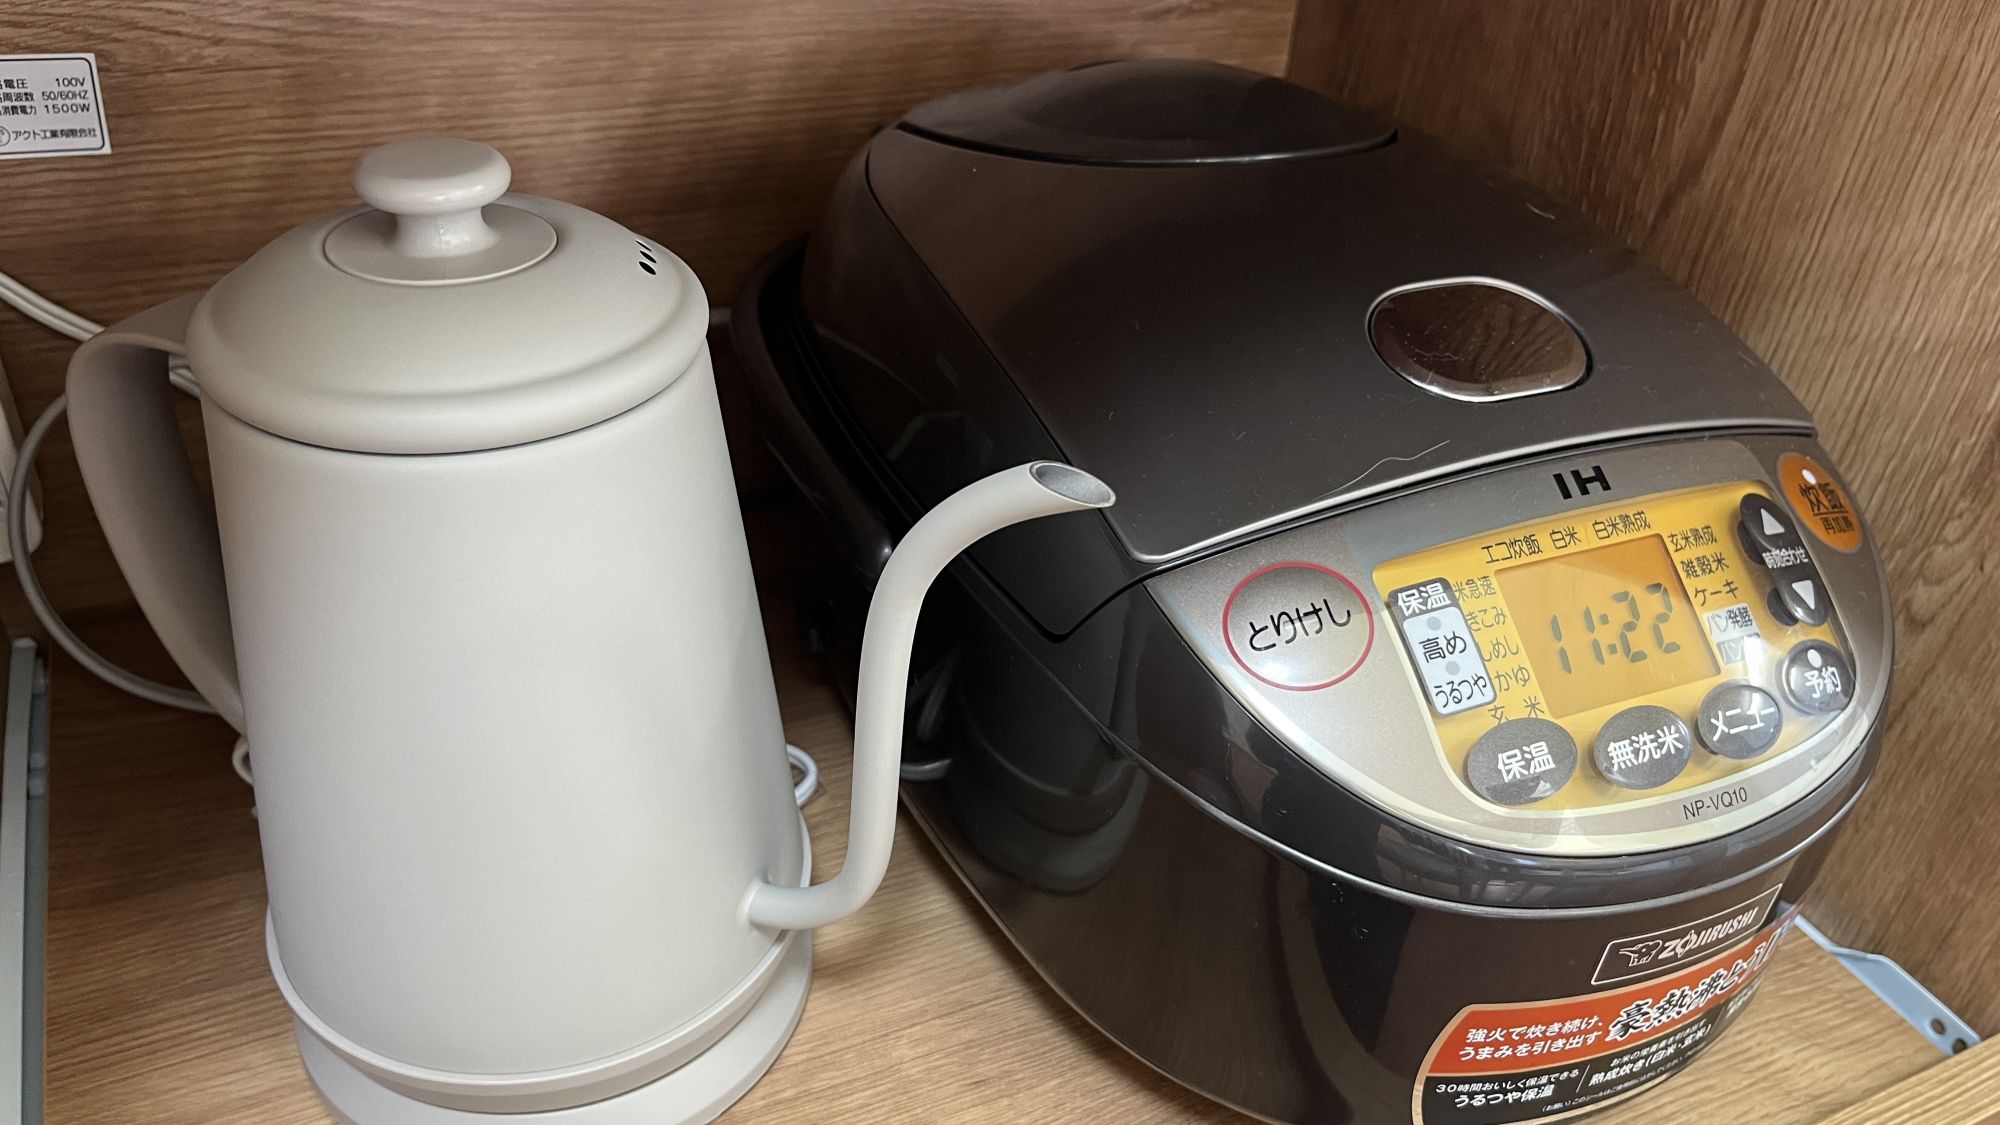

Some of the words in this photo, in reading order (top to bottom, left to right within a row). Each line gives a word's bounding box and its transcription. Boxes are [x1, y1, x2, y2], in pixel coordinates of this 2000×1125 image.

[56, 77, 85, 88] 100V
[0, 104, 37, 116] 消費電力
[44, 103, 91, 114] 1500W
[1553, 465, 1612, 500] IH
[1799, 482, 1846, 512] 炊飯
[1481, 533, 1543, 564] エコ炊飯
[1549, 525, 1582, 550] 白米
[1592, 510, 1651, 540] 白米熟成
[1667, 524, 1717, 553] 玄米熟成
[1680, 551, 1730, 580] 雑穀米
[1761, 546, 1809, 570] 時刻合わせ
[1397, 582, 1451, 617] 保温
[1694, 579, 1739, 606] ケーキ
[1249, 598, 1352, 652] とりけし
[1547, 581, 1681, 674] 11:22
[1708, 607, 1753, 636] パン発酵
[1419, 630, 1467, 664] 高め
[1720, 640, 1747, 664] パン
[1434, 672, 1487, 708] うるつや
[1494, 664, 1531, 692] かゆ
[1804, 665, 1842, 698] 予約
[1710, 700, 1776, 742] メニュー
[1496, 740, 1556, 783] 保温
[1606, 725, 1686, 771] 無洗米
[1682, 786, 1749, 820] NP-VQ10
[1657, 906, 1759, 960] ZOJIRUSHI
[1465, 1015, 1603, 1043] 強火で炊き続け、
[1458, 1030, 1603, 1061] うまみを引き出す
[1435, 1068, 1580, 1093] 30時間おいしく保温できる
[1454, 1084, 1556, 1108] うるつや保温
